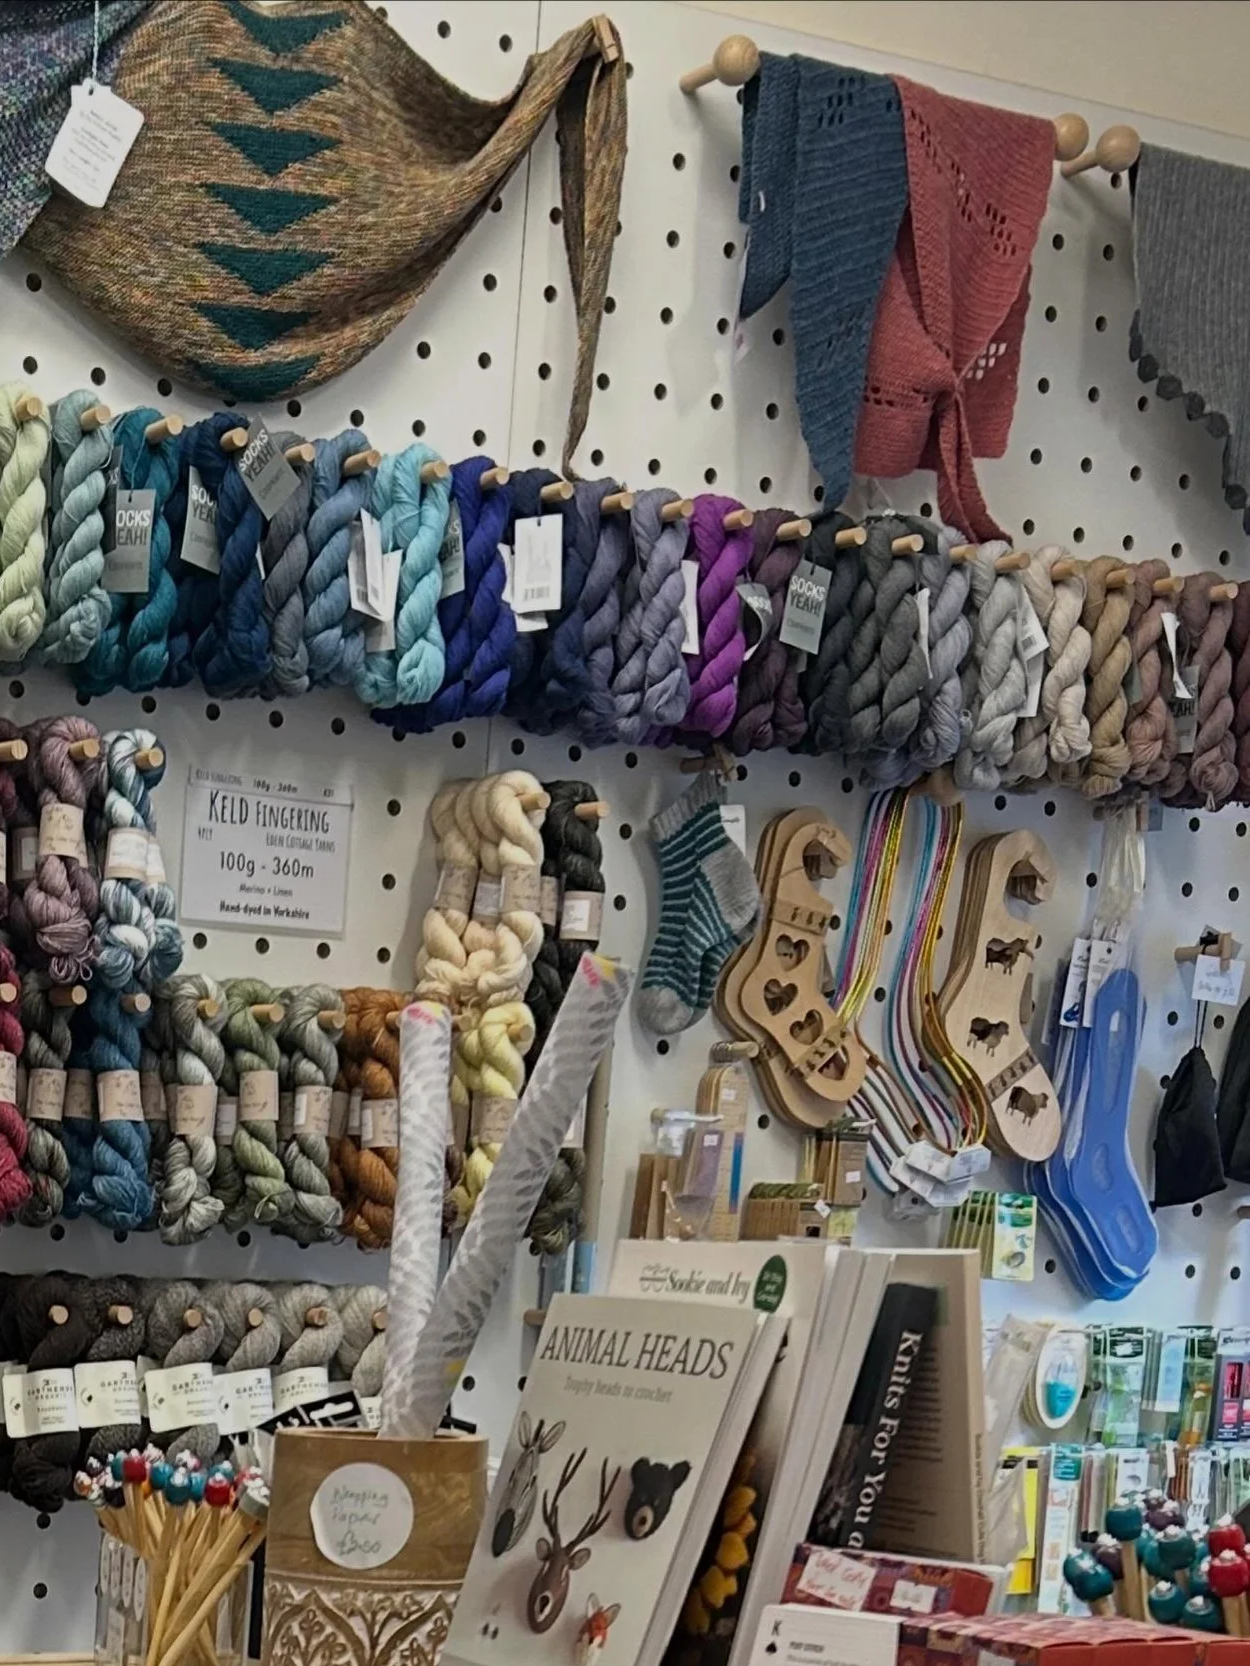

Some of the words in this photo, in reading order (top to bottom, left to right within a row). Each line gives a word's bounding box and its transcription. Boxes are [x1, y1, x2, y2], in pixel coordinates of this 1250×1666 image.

[238, 428, 269, 473] SOCKS
[245, 444, 275, 482] YEAH!
[190, 484, 216, 506] SOC
[116, 509, 151, 526] OCKS
[117, 528, 147, 546] EAH!
[790, 575, 826, 602] SOCKS
[789, 592, 822, 617] YEAH!
[208, 789, 249, 825] KELD
[255, 800, 330, 834] FINGERING
[220, 851, 256, 878] 100g
[272, 856, 315, 879] 360m
[273, 905, 310, 920] Yorkshire
[706, 1274, 730, 1295] and
[540, 1325, 632, 1369] ANIMAL
[634, 1333, 735, 1380] HEADS
[883, 1329, 924, 1410] Knits
[593, 1379, 621, 1398] heads
[870, 1414, 899, 1465] For
[854, 1471, 887, 1525] You
[770, 1620, 783, 1637] K
